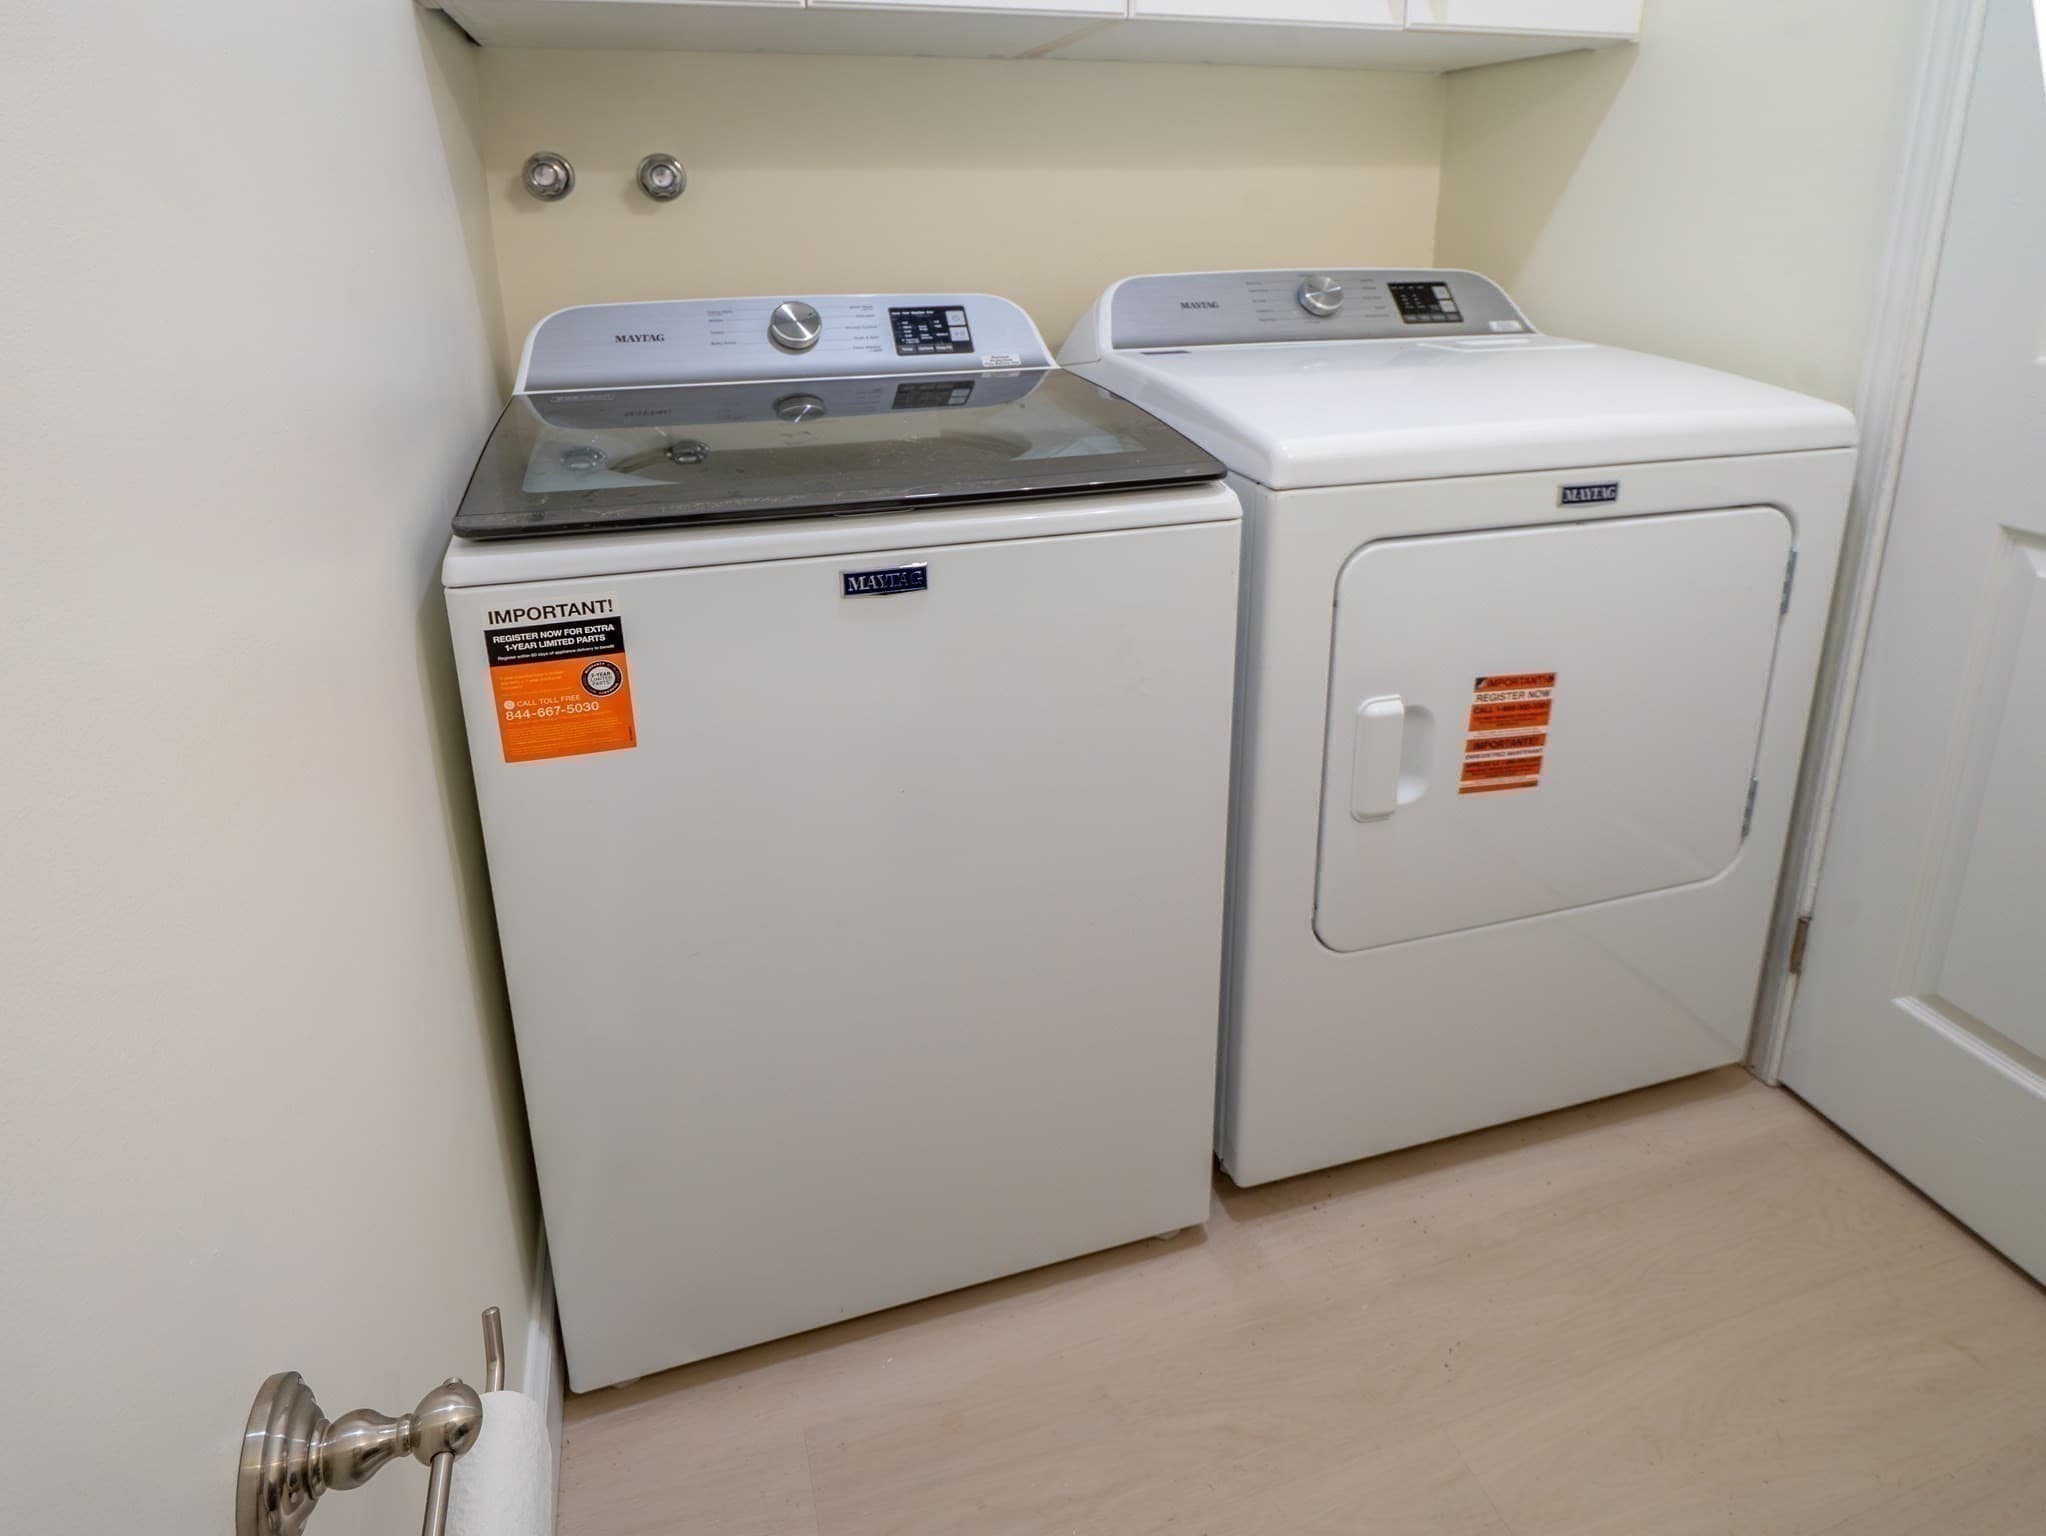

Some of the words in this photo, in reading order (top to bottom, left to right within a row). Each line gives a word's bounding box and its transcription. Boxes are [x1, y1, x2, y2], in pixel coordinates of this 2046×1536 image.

[615, 333, 664, 343] MAYTAG
[847, 570, 923, 592] MAYTAG
[488, 599, 613, 625] IMPORTANT!
[492, 632, 538, 643] REGISTER
[540, 630, 562, 638] NOW
[563, 627, 582, 636] FOR
[584, 624, 615, 634] EXTRA
[505, 642, 537, 651] 1-YEAR
[539, 638, 575, 648] LIMITED
[576, 634, 606, 644] PARTS
[516, 699, 537, 707] CALL
[539, 697, 560, 705] TOLL
[1476, 691, 1525, 702] REGISTER
[1528, 689, 1550, 699] NOW
[505, 701, 600, 721] 844-667-5030
